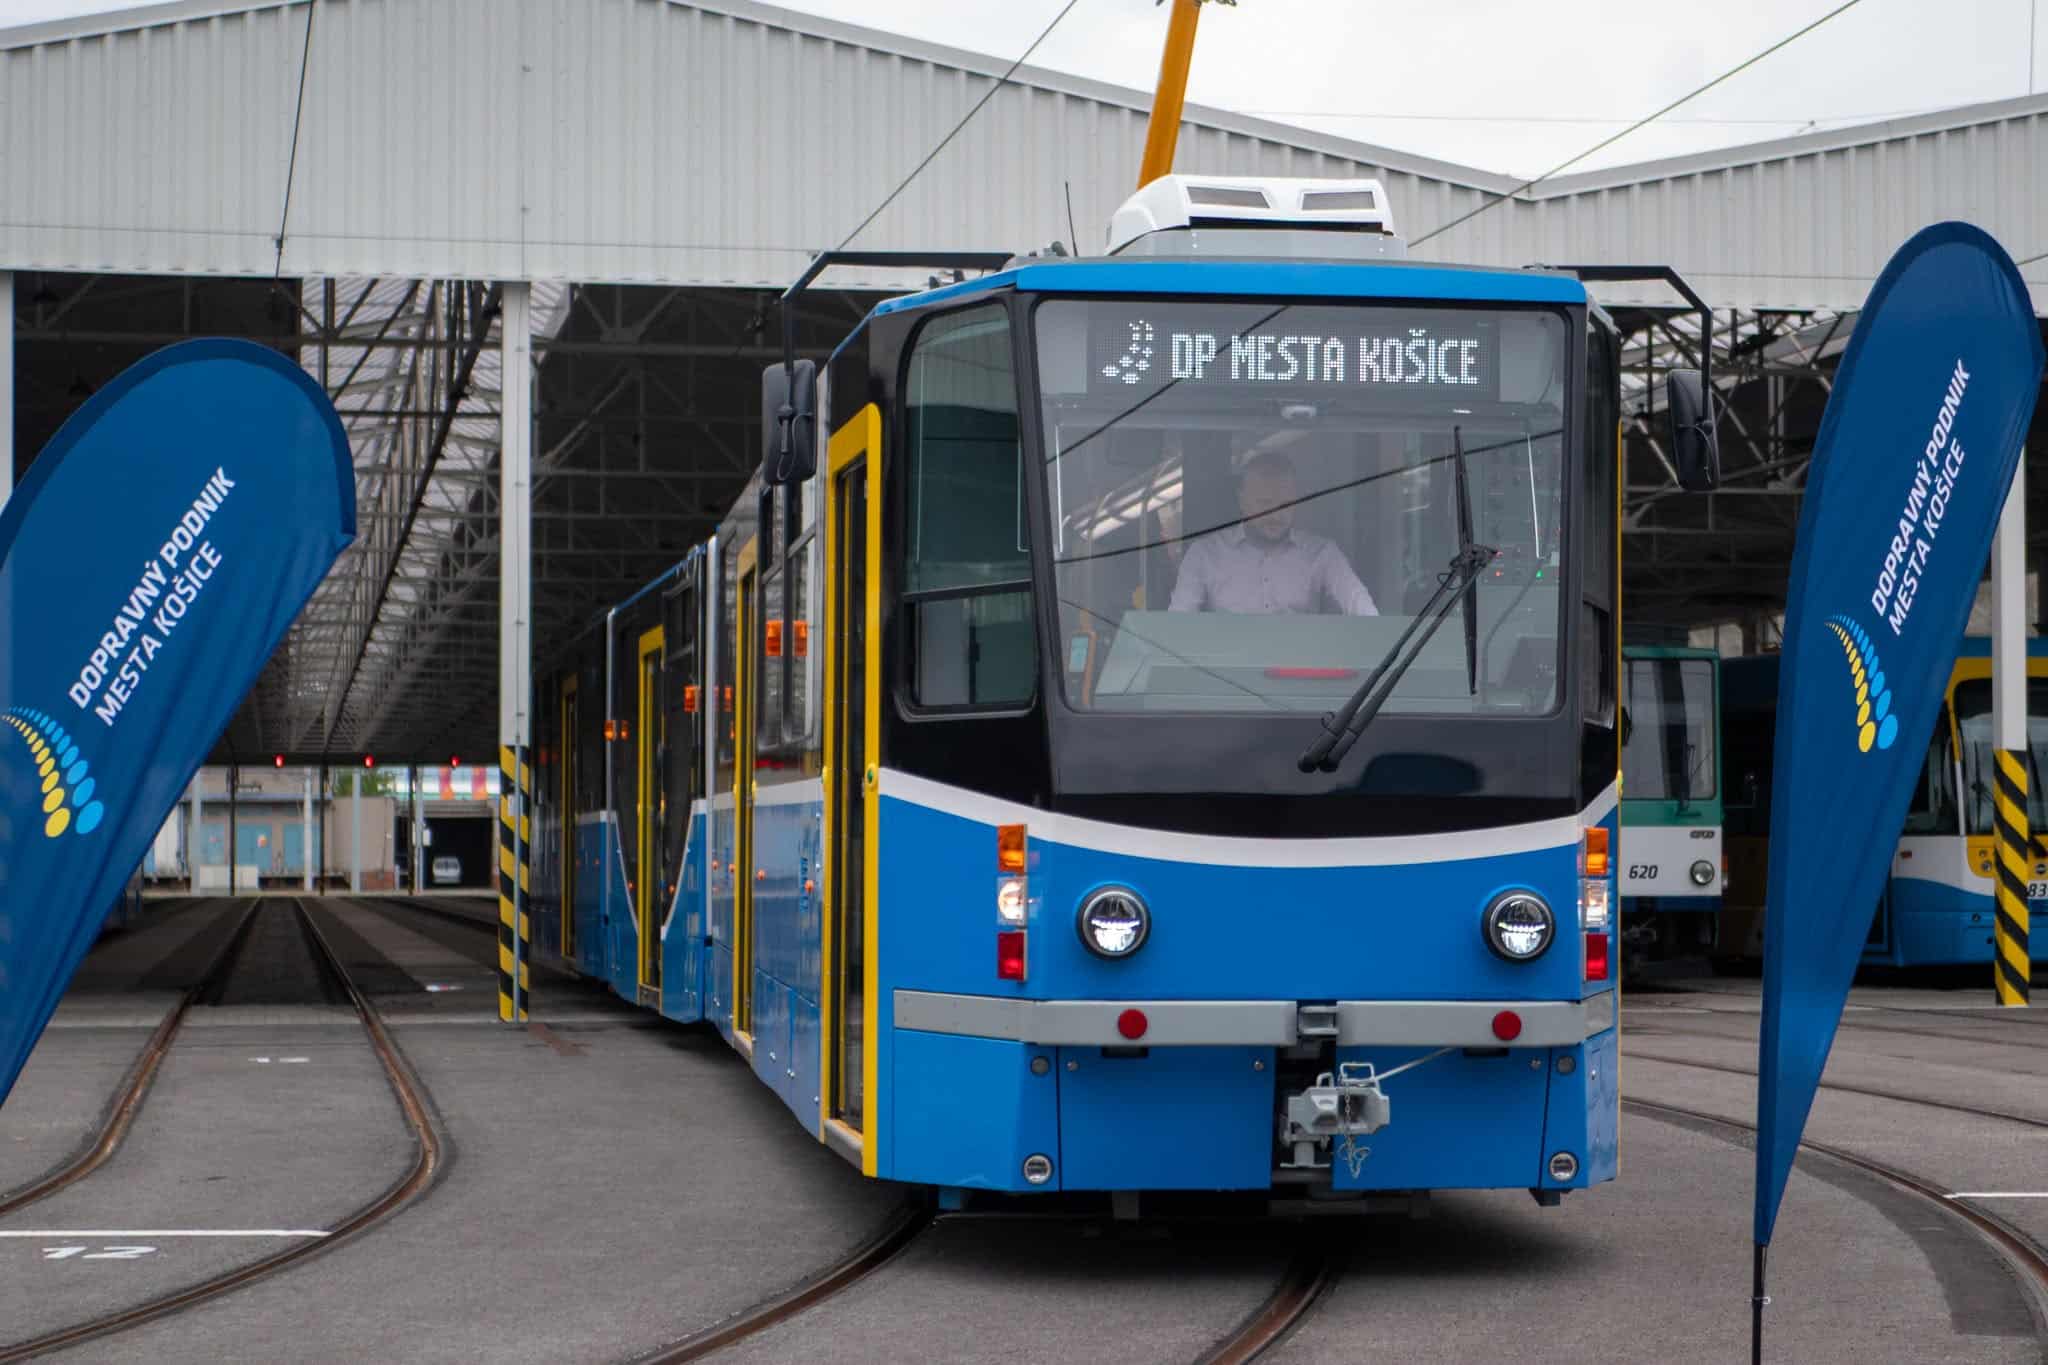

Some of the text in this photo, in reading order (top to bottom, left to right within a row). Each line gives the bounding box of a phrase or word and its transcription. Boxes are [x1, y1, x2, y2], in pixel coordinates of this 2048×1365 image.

[1171, 328, 1478, 385] DP MESTA KOŠICE
[1871, 358, 1970, 617] DOPRAVNÝ PODNIK
[1888, 437, 1966, 636] MESTA KOŠICE
[69, 466, 236, 709] DOPRAVNÝ PODNIK
[95, 540, 223, 727] MESTA KOŠICE
[1628, 864, 1659, 880] 620
